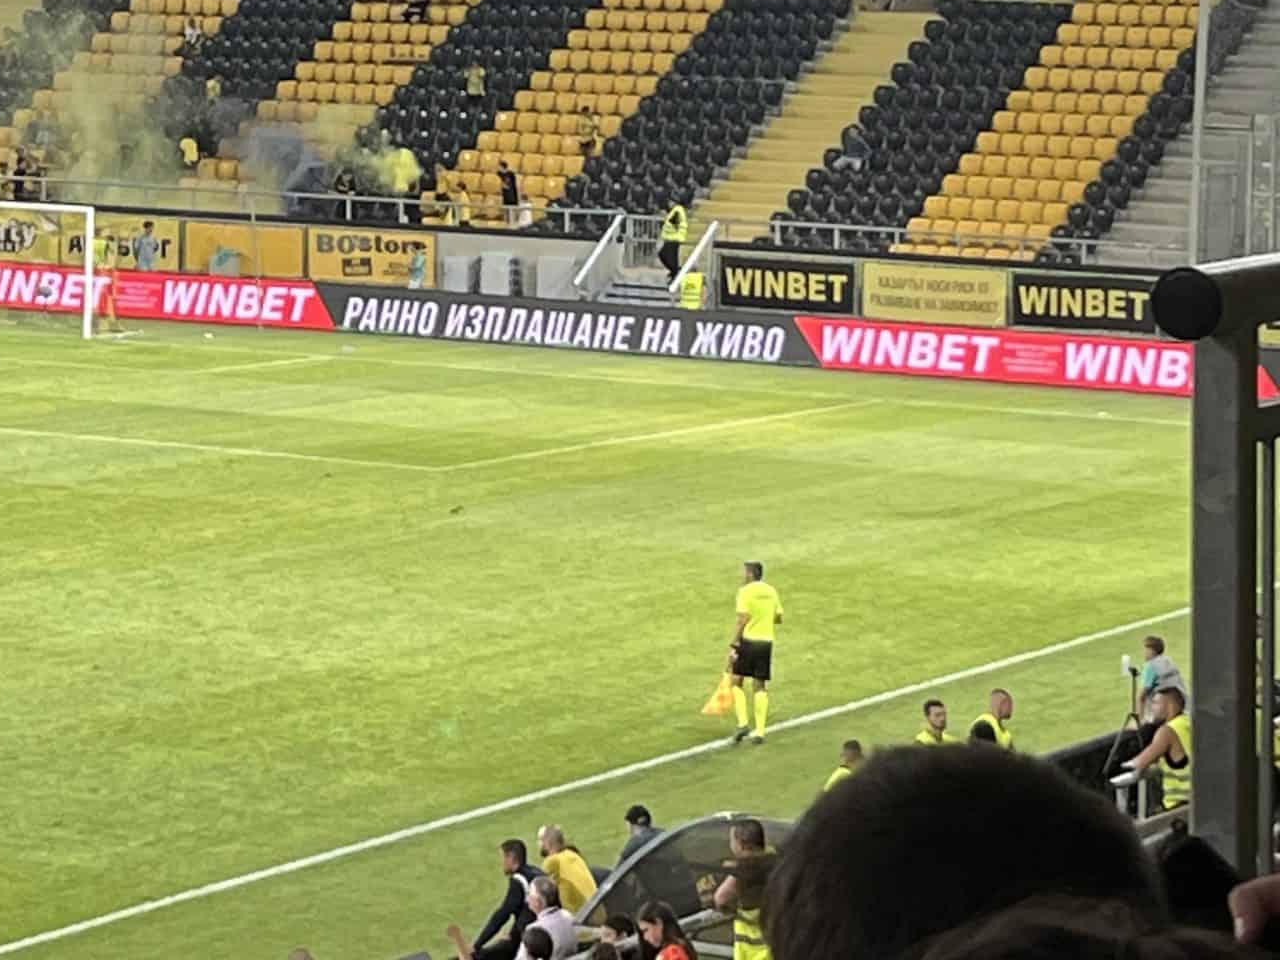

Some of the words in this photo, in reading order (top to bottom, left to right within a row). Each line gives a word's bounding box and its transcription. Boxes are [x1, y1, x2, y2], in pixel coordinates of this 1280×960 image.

[162, 278, 314, 322] WINBET
[725, 267, 849, 303] WINBET
[1018, 284, 1150, 321] WINBET
[343, 296, 439, 336] РАННО
[640, 318, 681, 356] НА
[689, 320, 786, 362] ЖИВО
[822, 324, 1002, 374] WINBET
[1064, 341, 1189, 387] WINB
